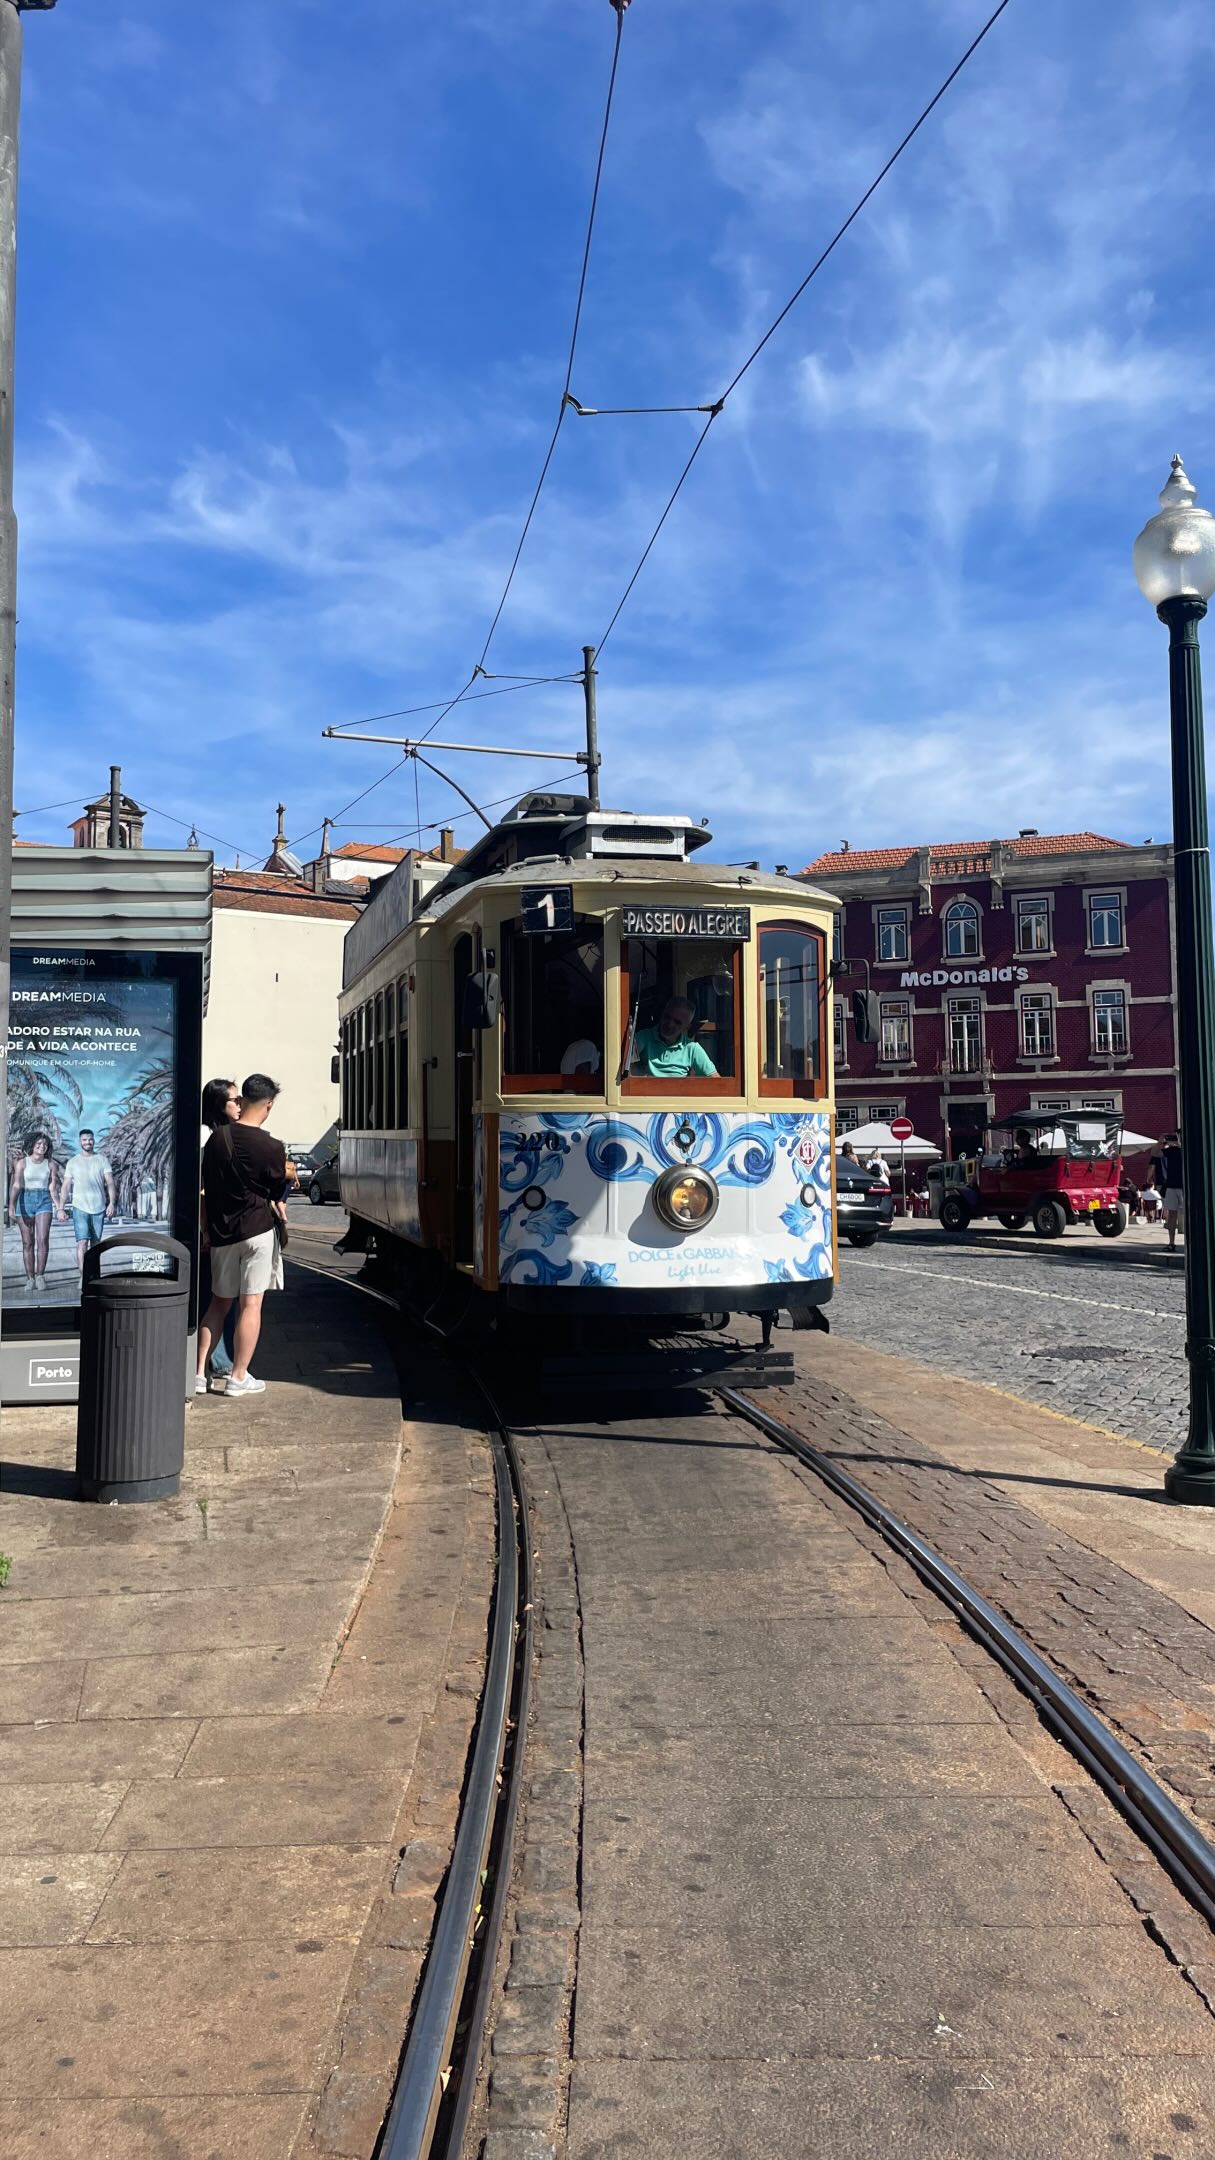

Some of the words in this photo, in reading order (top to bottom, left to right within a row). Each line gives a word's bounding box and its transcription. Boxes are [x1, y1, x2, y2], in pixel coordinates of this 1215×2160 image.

[537, 892, 555, 928] 1
[627, 911, 685, 933] PASSEIO
[688, 914, 742, 935] ALEGRE
[900, 966, 1029, 987] McDonald's
[7, 1026, 50, 1036] ADORO
[53, 1026, 92, 1036] ESTAR
[94, 1027, 112, 1037] NA
[115, 1027, 141, 1037] RUA
[7, 1041, 24, 1050] DE
[26, 1041, 36, 1050] A
[38, 1041, 69, 1051] VIDA
[71, 1042, 137, 1052] ACONTECE
[6, 1059, 49, 1067] OMUNIQUE
[628, 1250, 674, 1263] DOLCE
[37, 1366, 72, 1379] Porto
